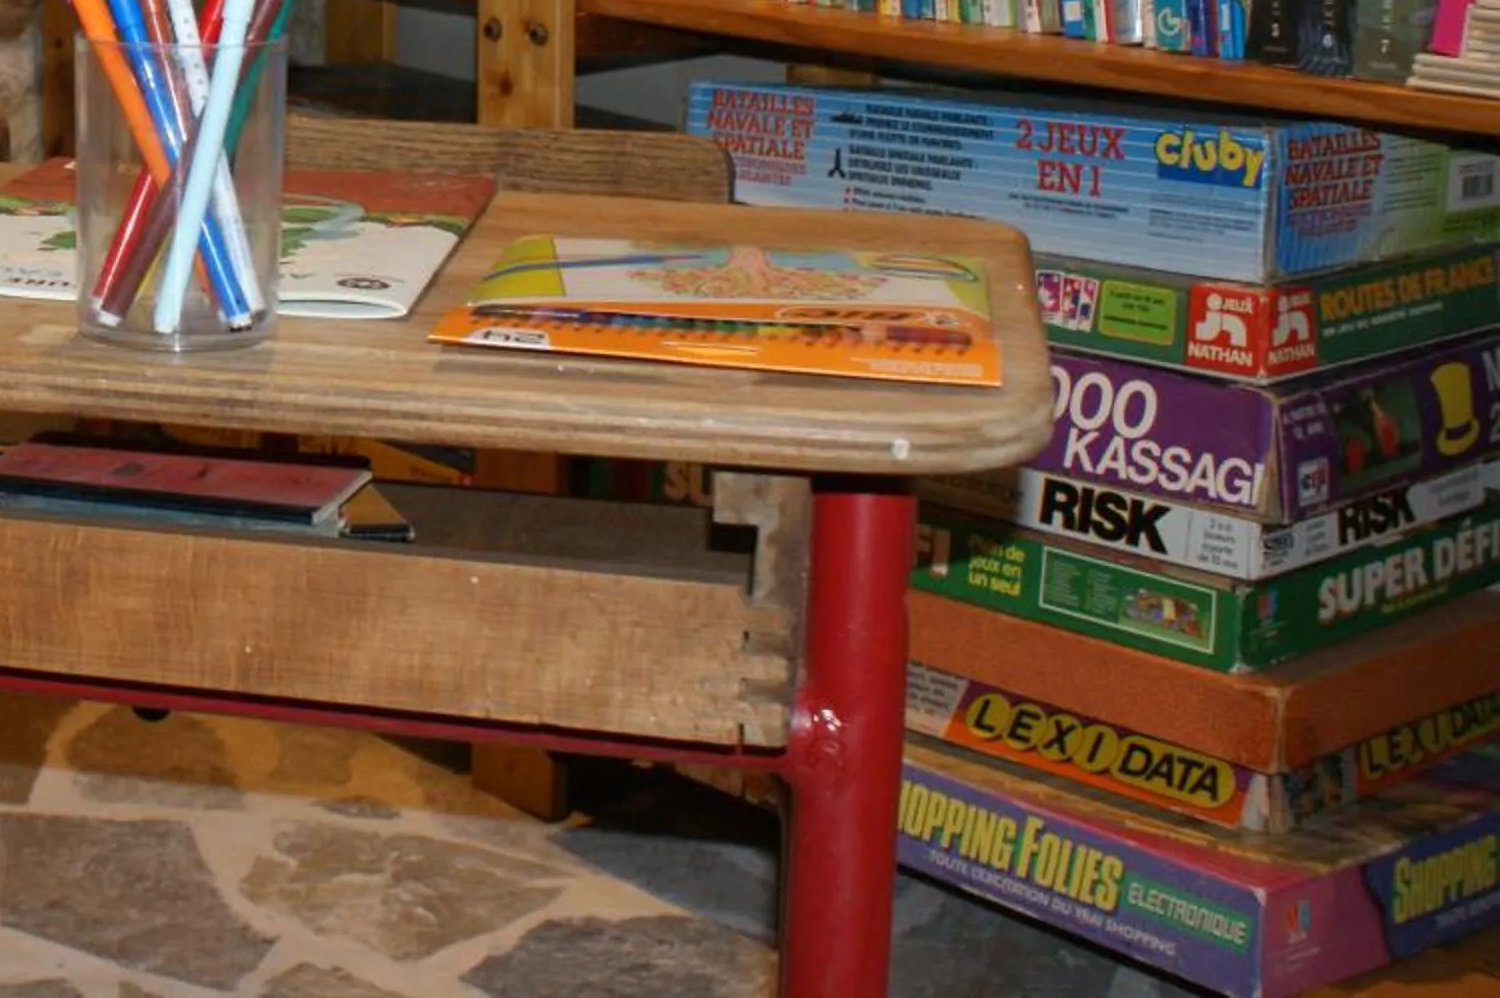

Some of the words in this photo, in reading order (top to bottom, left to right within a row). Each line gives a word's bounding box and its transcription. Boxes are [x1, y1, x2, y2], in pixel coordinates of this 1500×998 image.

[1015, 118, 1034, 151] 2
[1035, 123, 1126, 160] JEUX
[1036, 159, 1085, 195] EN
[1187, 341, 1253, 368] NATHAN
[1038, 476, 1172, 555] RISK
[1317, 545, 1428, 628] SUPER
[1017, 813, 1124, 912] FOLIES
